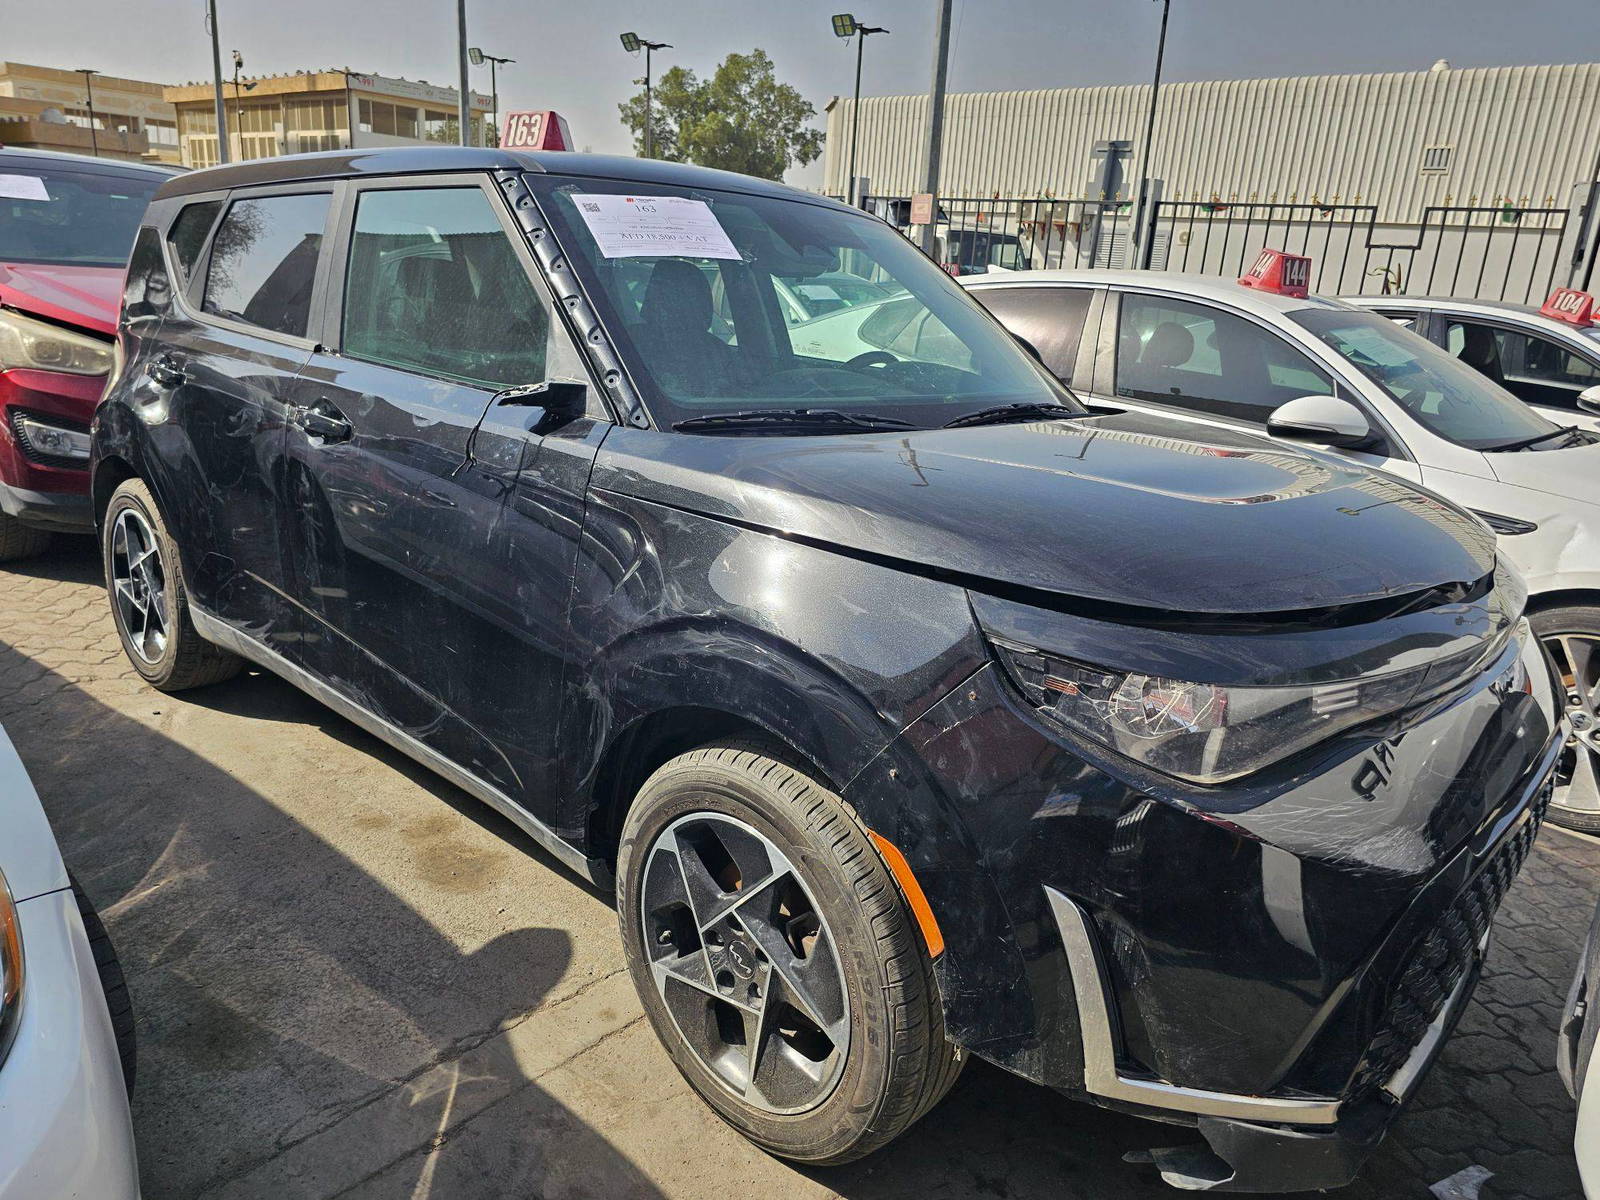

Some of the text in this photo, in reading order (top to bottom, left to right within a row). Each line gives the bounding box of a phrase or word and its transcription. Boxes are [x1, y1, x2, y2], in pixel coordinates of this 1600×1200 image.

[507, 114, 542, 147] 163
[635, 204, 658, 213] 163
[1249, 252, 1274, 279] 144
[1285, 259, 1307, 286] 144
[1553, 291, 1585, 314] 104
